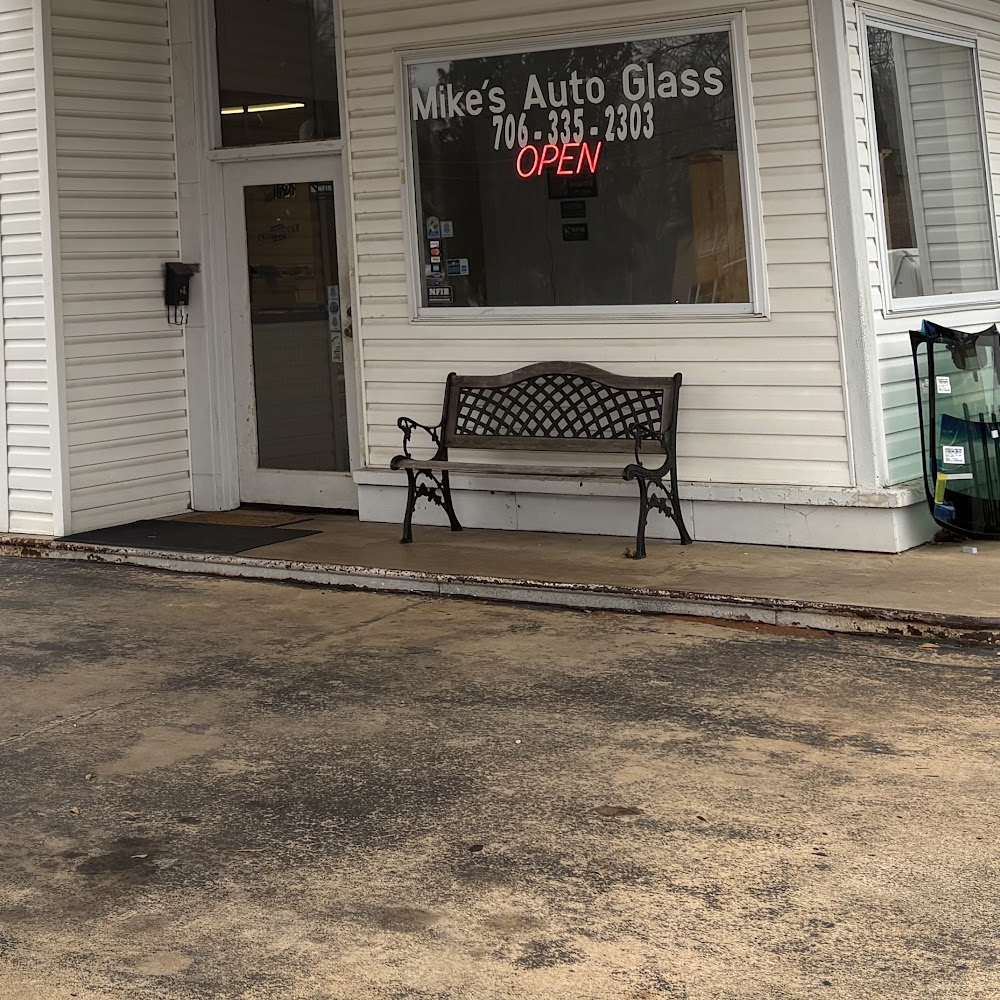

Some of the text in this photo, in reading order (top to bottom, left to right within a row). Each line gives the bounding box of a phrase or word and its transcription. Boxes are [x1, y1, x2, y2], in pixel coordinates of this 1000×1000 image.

[412, 63, 724, 121] Mike's Auto Glass
[516, 141, 602, 178] OPEN
